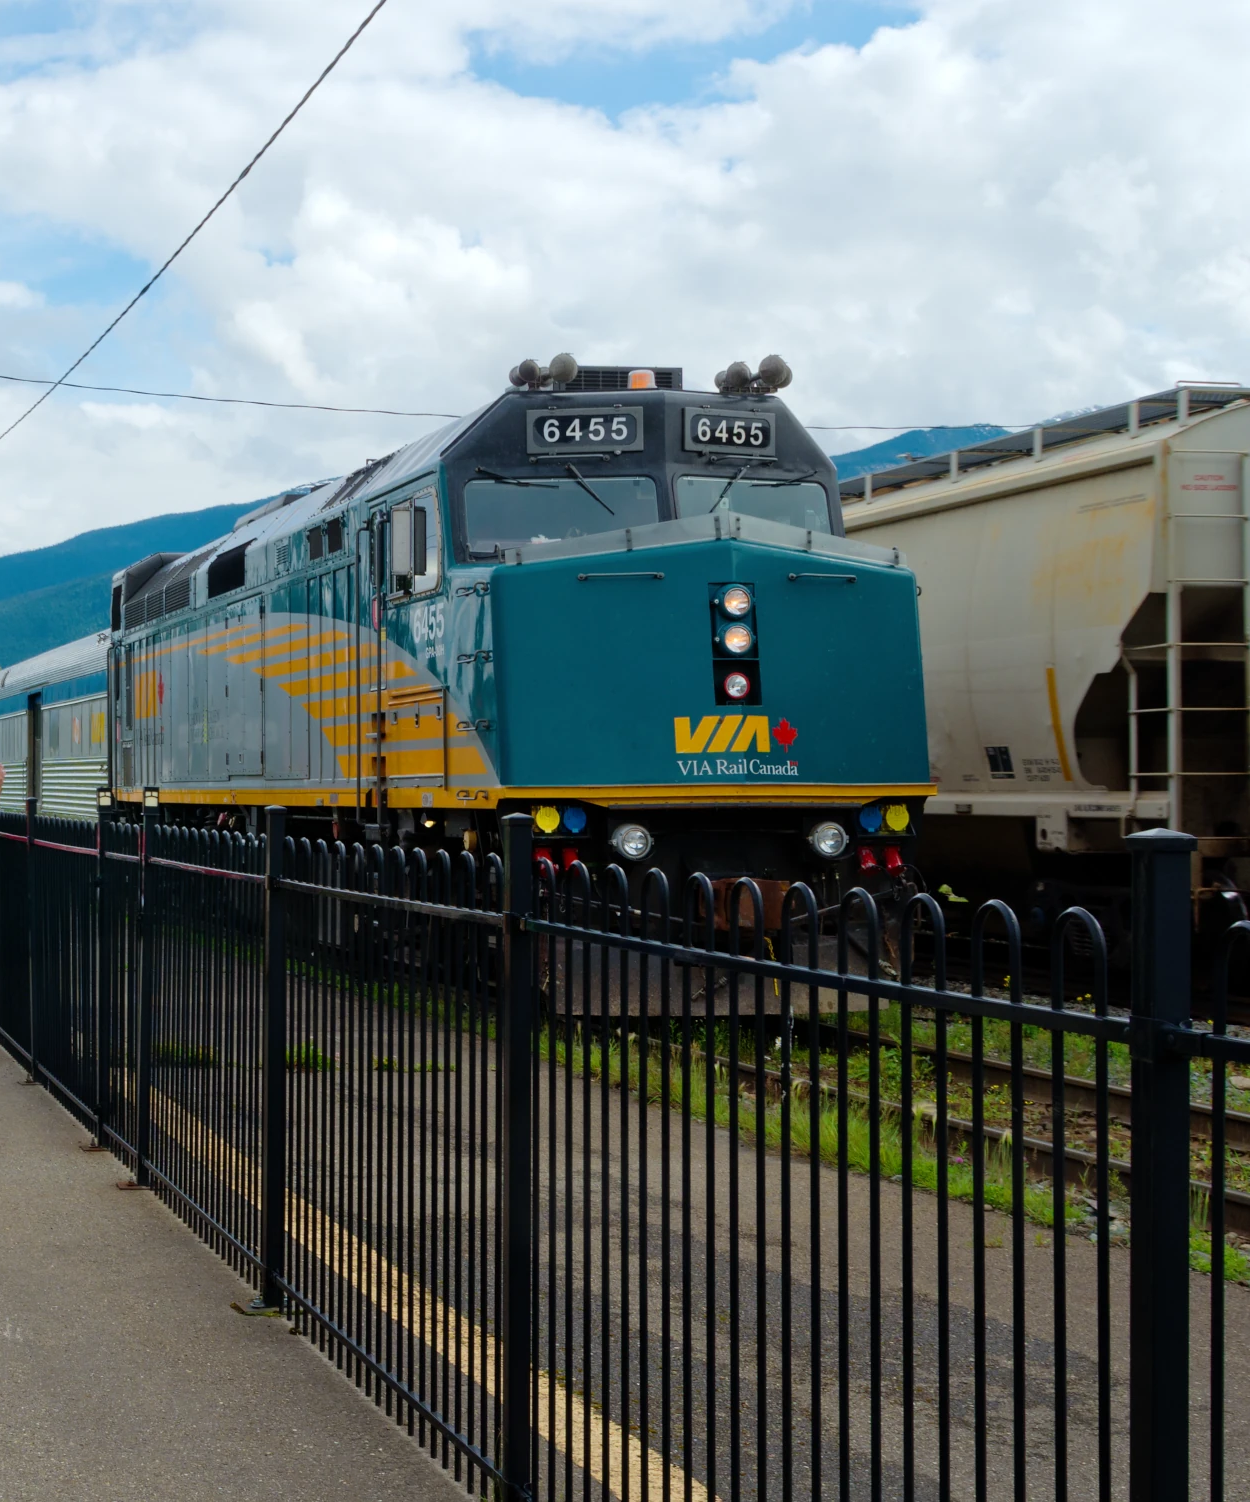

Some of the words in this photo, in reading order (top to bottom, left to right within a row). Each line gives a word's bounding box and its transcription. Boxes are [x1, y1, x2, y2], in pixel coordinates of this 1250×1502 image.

[543, 417, 627, 443] 6455
[697, 418, 763, 446] 6455
[413, 602, 445, 644] 6455
[674, 715, 771, 754] VIA
[676, 760, 714, 776] VIA
[715, 758, 748, 775] Rail
[749, 758, 799, 776] Canada
